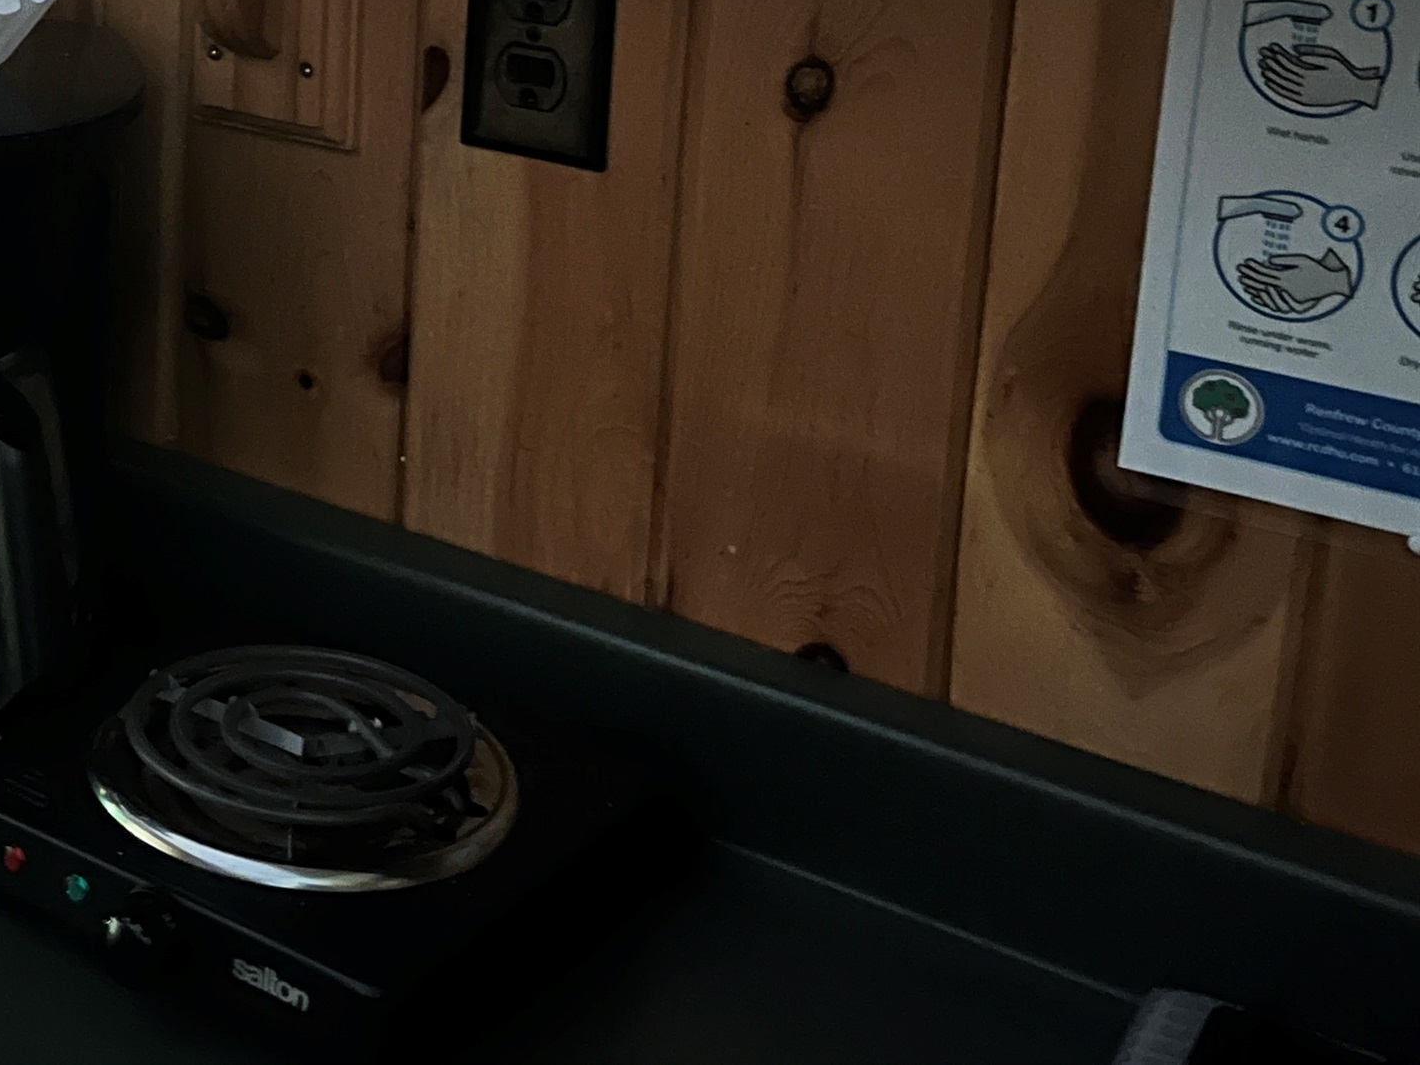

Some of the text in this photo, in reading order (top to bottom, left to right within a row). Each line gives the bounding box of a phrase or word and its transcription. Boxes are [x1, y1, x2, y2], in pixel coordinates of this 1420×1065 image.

[1366, 3, 1378, 23] 1
[1334, 215, 1350, 233] 4
[231, 957, 310, 1012] salton
